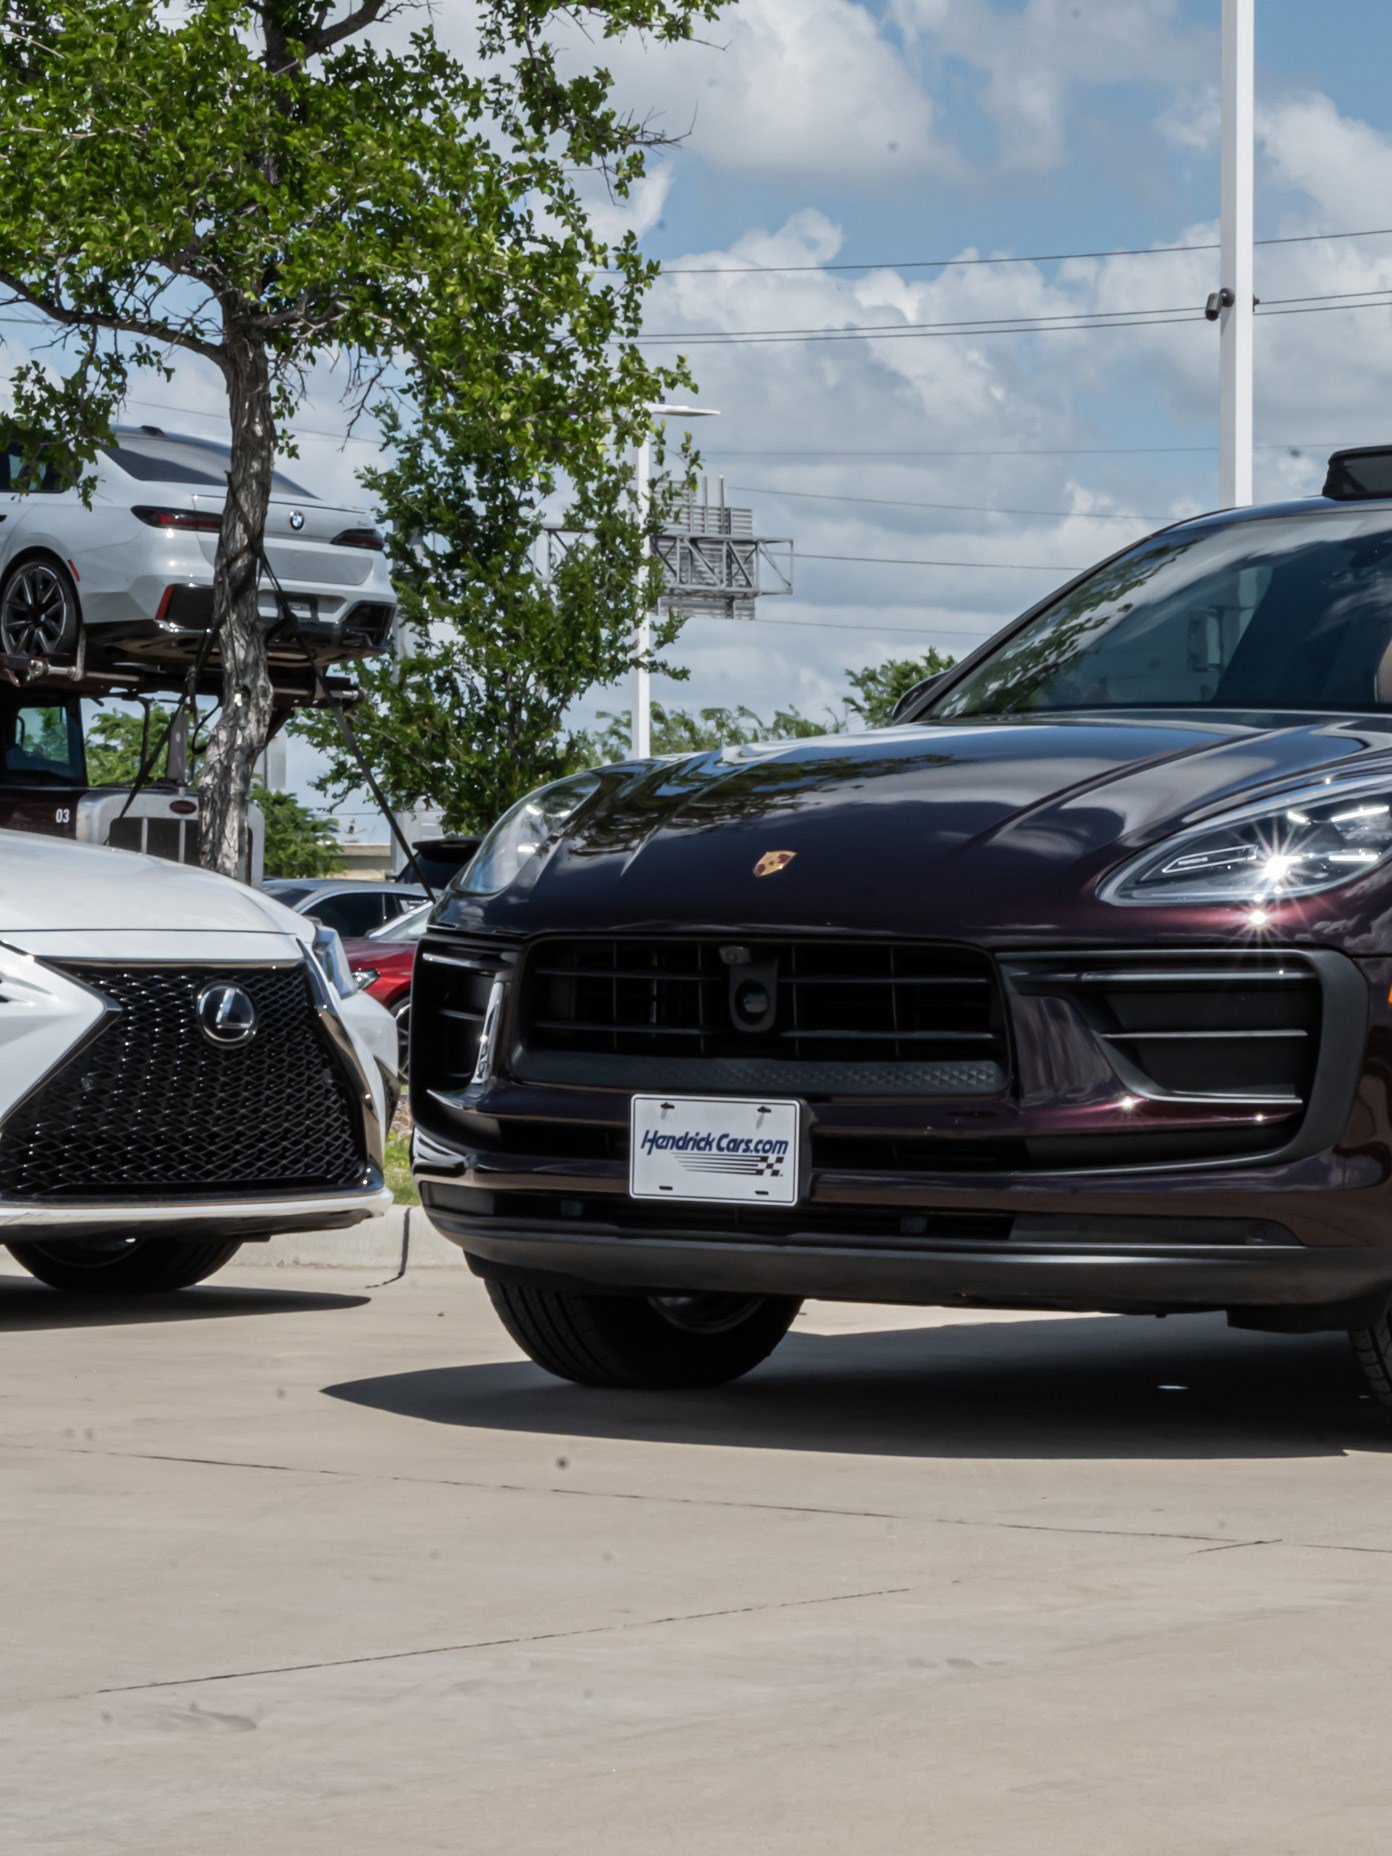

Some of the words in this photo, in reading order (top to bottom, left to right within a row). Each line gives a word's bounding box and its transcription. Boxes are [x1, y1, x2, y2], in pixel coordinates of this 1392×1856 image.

[55, 808, 70, 824] 03
[640, 1129, 716, 1155] Hendrick
[716, 1133, 789, 1155] Cars.com
